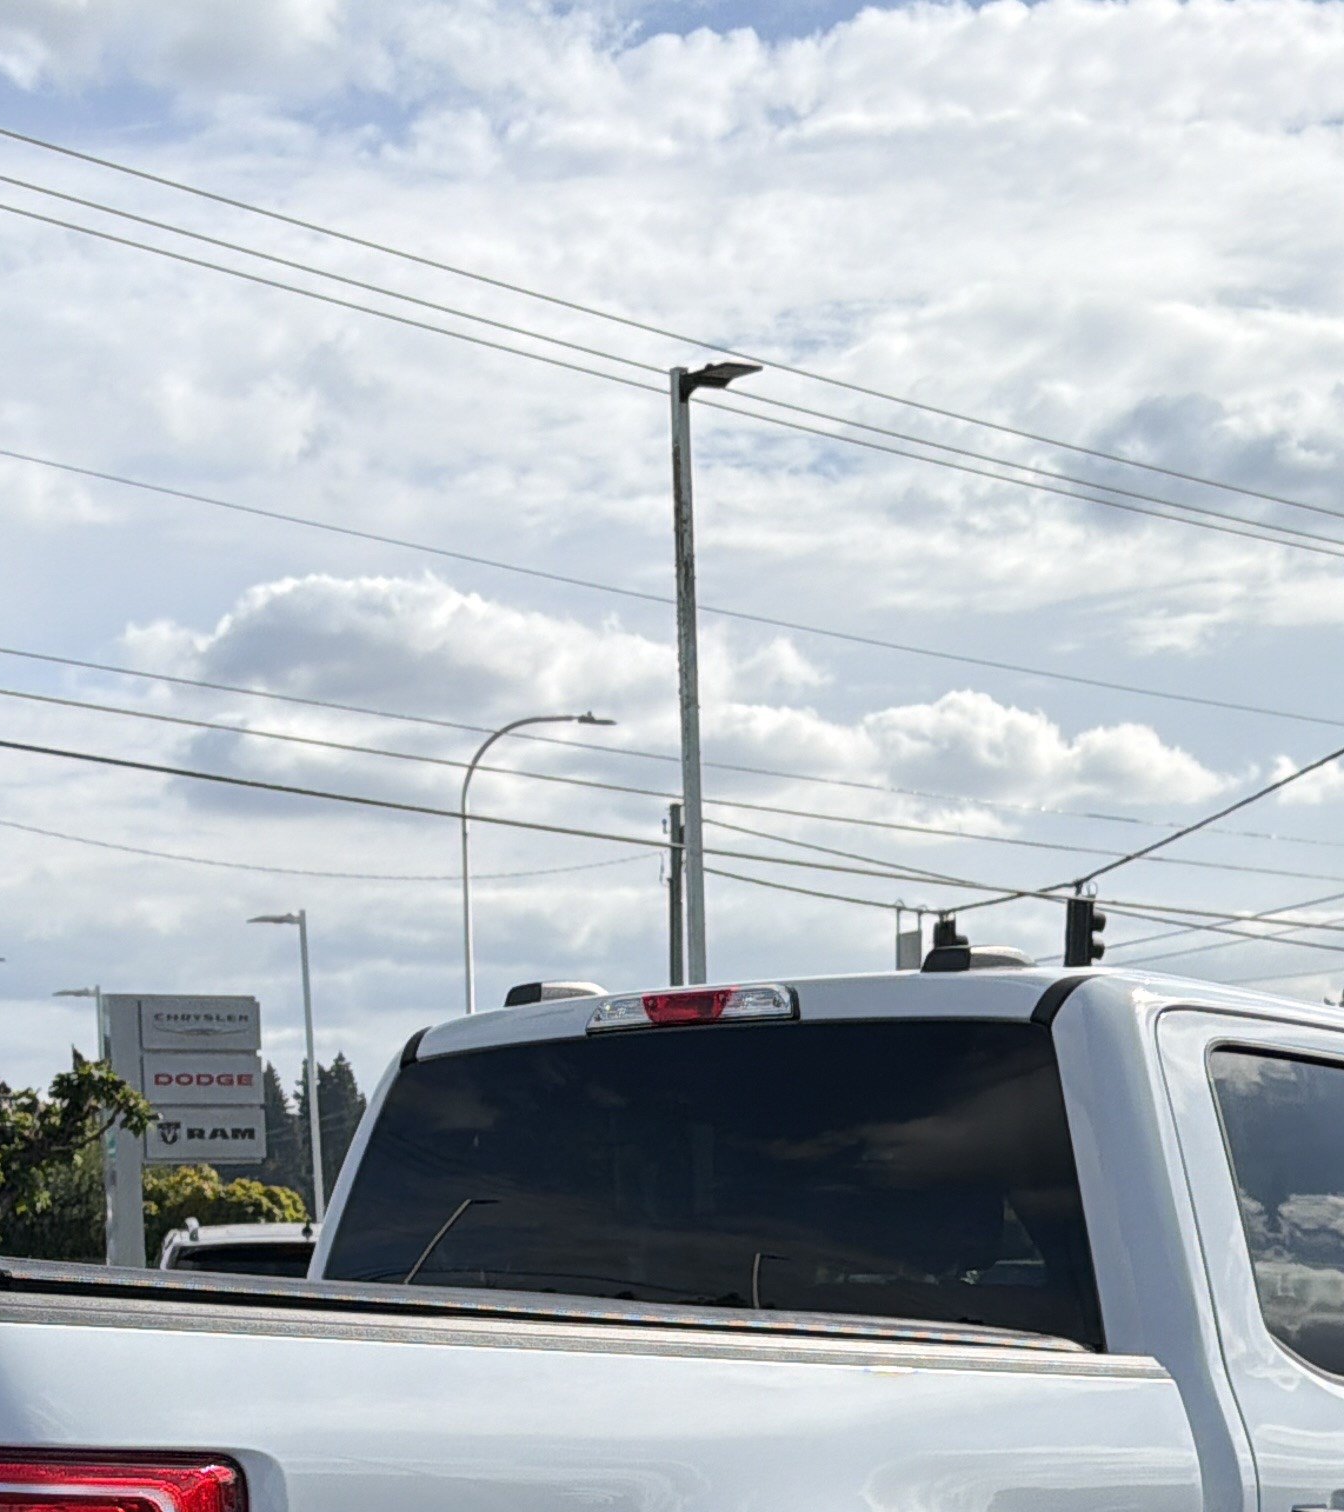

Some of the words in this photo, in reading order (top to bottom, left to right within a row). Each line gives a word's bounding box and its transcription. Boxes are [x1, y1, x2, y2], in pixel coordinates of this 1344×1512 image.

[154, 1012, 249, 1022] CHRYSLER
[154, 1073, 254, 1087] DODGE
[186, 1127, 256, 1140] RAM
